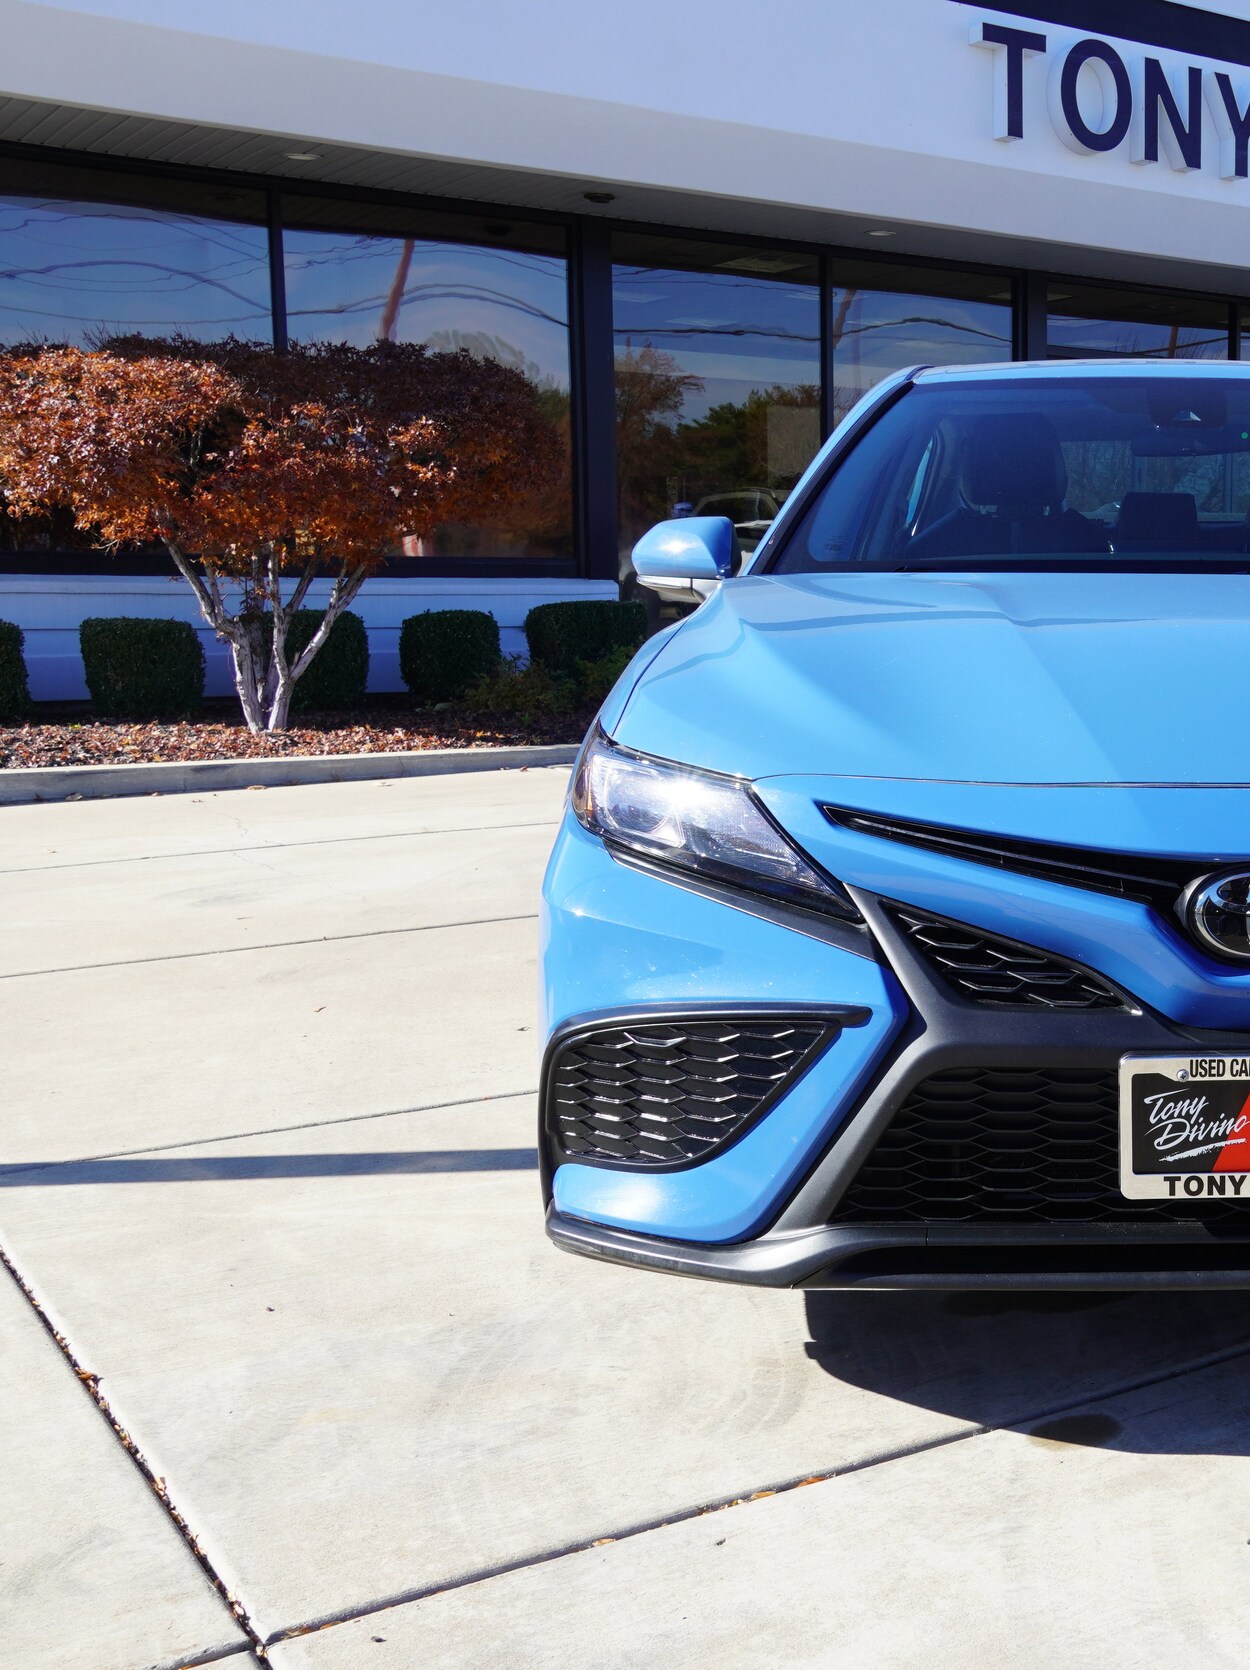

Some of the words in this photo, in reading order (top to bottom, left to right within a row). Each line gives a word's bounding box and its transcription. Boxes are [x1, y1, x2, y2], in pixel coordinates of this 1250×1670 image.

[1189, 1059, 1226, 1079] USED
[1143, 1088, 1209, 1124] Tony
[1144, 1113, 1250, 1150] Divino
[1163, 1175, 1247, 1197] TONY
